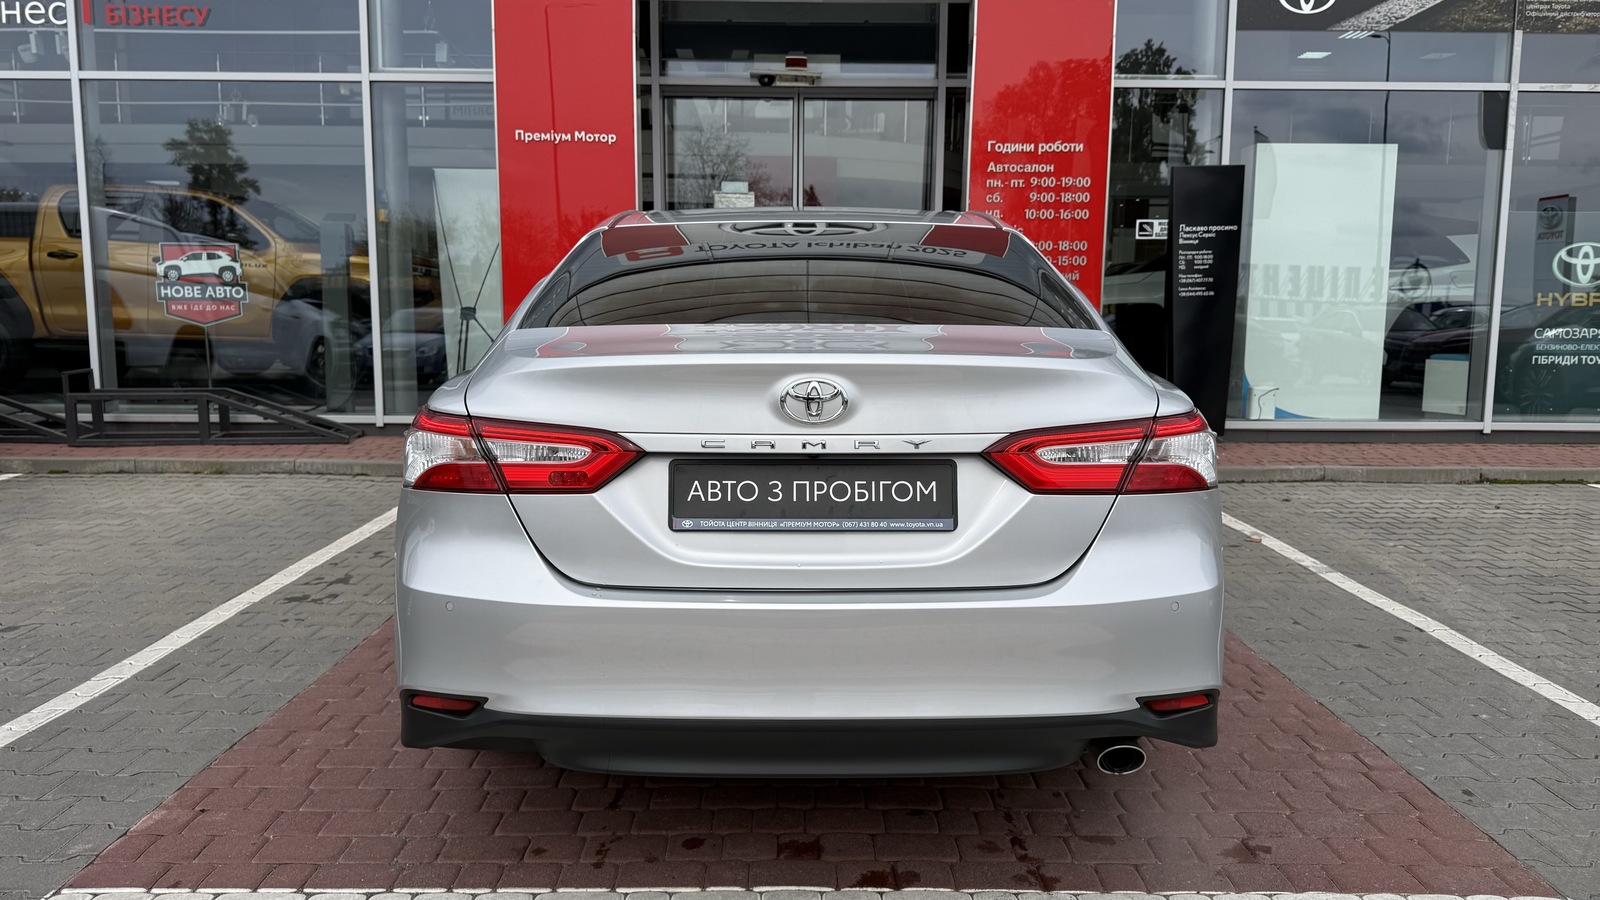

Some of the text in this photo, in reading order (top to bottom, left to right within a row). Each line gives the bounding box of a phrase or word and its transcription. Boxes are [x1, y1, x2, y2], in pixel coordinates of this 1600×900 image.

[105, 5, 210, 26] БІЗНЕСУ
[515, 129, 617, 145] Преміум Мотор
[987, 140, 1084, 155] Години роботи
[987, 162, 1055, 173] Автосалон
[1030, 176, 1091, 188] 9:00-19:00
[986, 192, 1090, 203] сб. 9:00-18:00
[1024, 208, 1090, 220] 10:00-16:00
[1179, 224, 1238, 233] Ласкаво просимо
[1032, 241, 1088, 252] :00-18:00
[160, 285, 244, 299] НОВЕ АВТО
[206, 304, 217, 312] ДО
[219, 304, 236, 312] НАС
[1535, 343, 1600, 351] БЕНЗИНОВО-ЕЛЕК
[1531, 355, 1579, 367] ГІБРИДИ
[701, 439, 933, 450] CAMRY
[687, 480, 759, 502] АВТО
[793, 480, 937, 502] ПРОБІГОМ
[700, 520, 725, 528] ТОЙОТА
[726, 520, 747, 529] ЦЕНТР
[748, 520, 778, 529] ВІННИЦЯ
[841, 521, 859, 529] (067)
